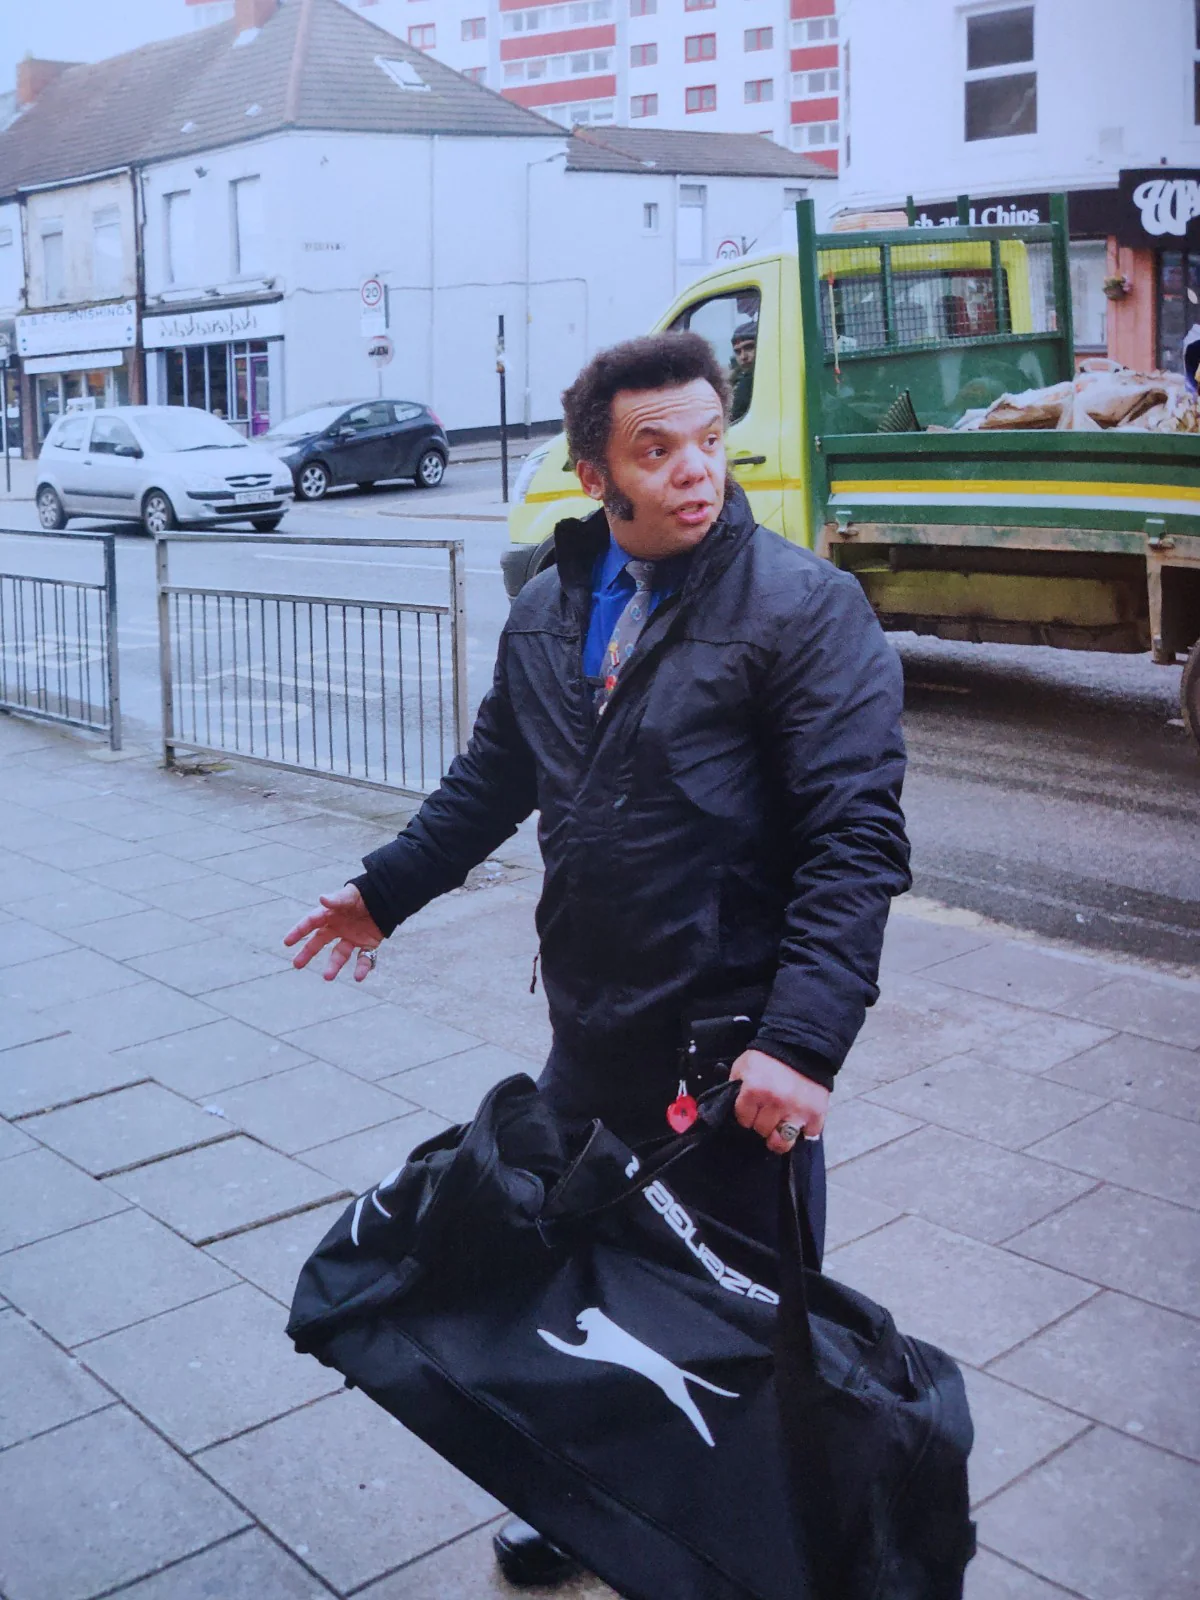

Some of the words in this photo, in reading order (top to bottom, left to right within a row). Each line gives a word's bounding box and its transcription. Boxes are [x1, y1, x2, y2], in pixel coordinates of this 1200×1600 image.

[914, 213, 934, 228] sh
[981, 204, 1040, 226] Chips
[365, 286, 379, 298] 20
